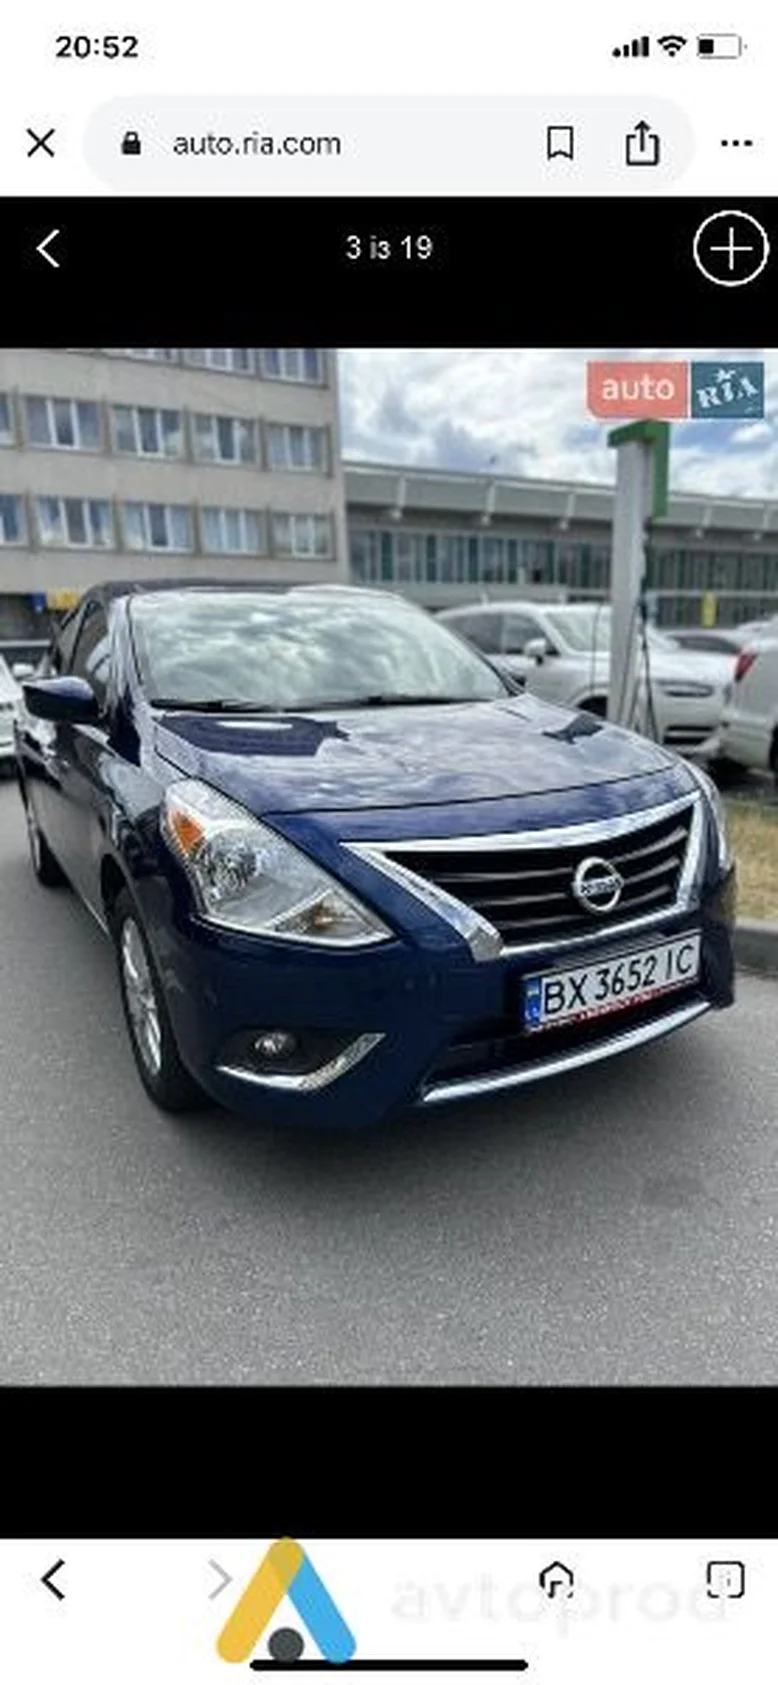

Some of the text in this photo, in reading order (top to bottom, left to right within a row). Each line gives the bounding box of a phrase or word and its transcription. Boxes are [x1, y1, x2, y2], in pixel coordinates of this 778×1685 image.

[55, 35, 138, 59] 20:52
[172, 131, 342, 157] auto.ria.com
[346, 234, 362, 260] 3
[400, 234, 433, 260] 19
[595, 956, 657, 1000] 3652
